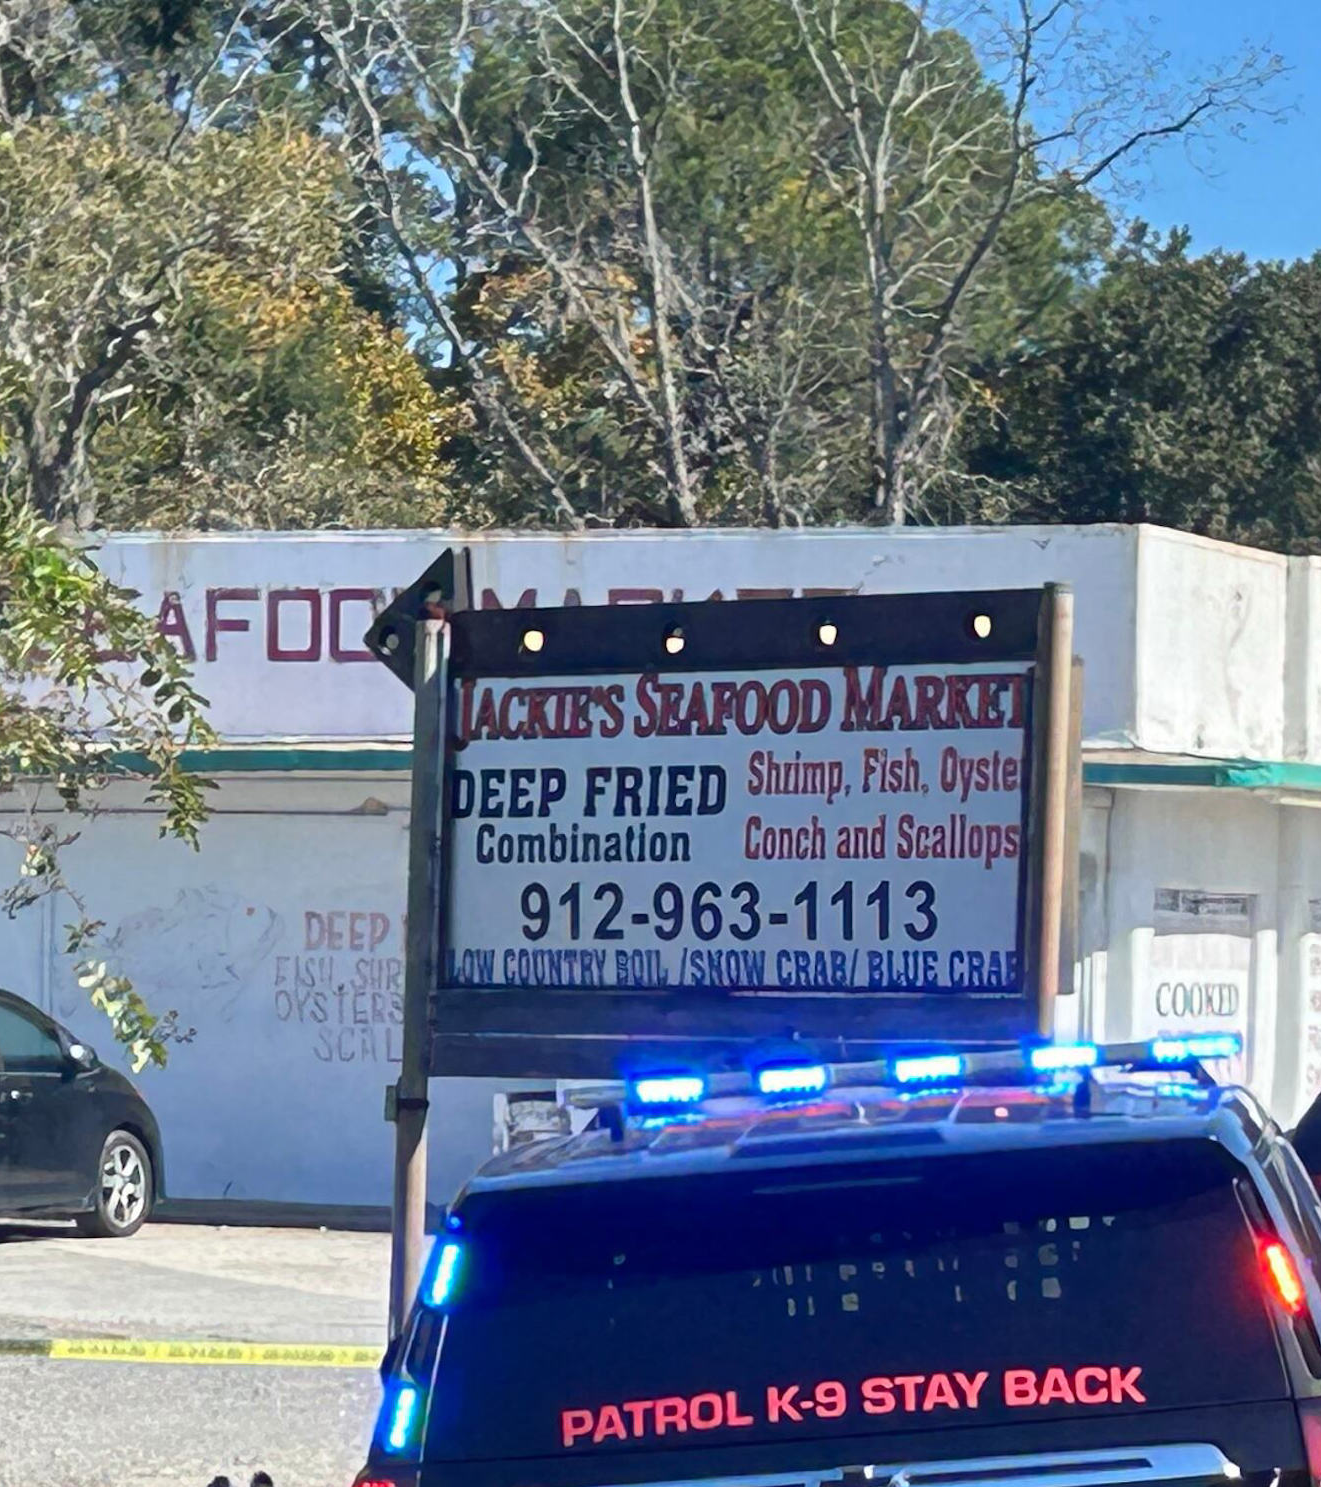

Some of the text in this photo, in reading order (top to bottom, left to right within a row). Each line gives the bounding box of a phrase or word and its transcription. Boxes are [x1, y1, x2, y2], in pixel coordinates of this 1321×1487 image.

[455, 677, 626, 751] JACKIE'S
[633, 672, 832, 739] SEAFOOD
[452, 764, 727, 820] DEEP FRIED
[747, 746, 1023, 805] Shrimp, Fish, Oyste
[476, 822, 691, 865] Combination
[744, 814, 1021, 870] Conch and Scallops
[304, 910, 391, 952] DEEP
[520, 880, 939, 942] 912-963-1113
[503, 947, 607, 987] COUNTRY
[616, 948, 670, 987] BOIL
[866, 949, 940, 988] BLUE
[562, 1366, 1147, 1447] PATROL K-9 STAY BACK
